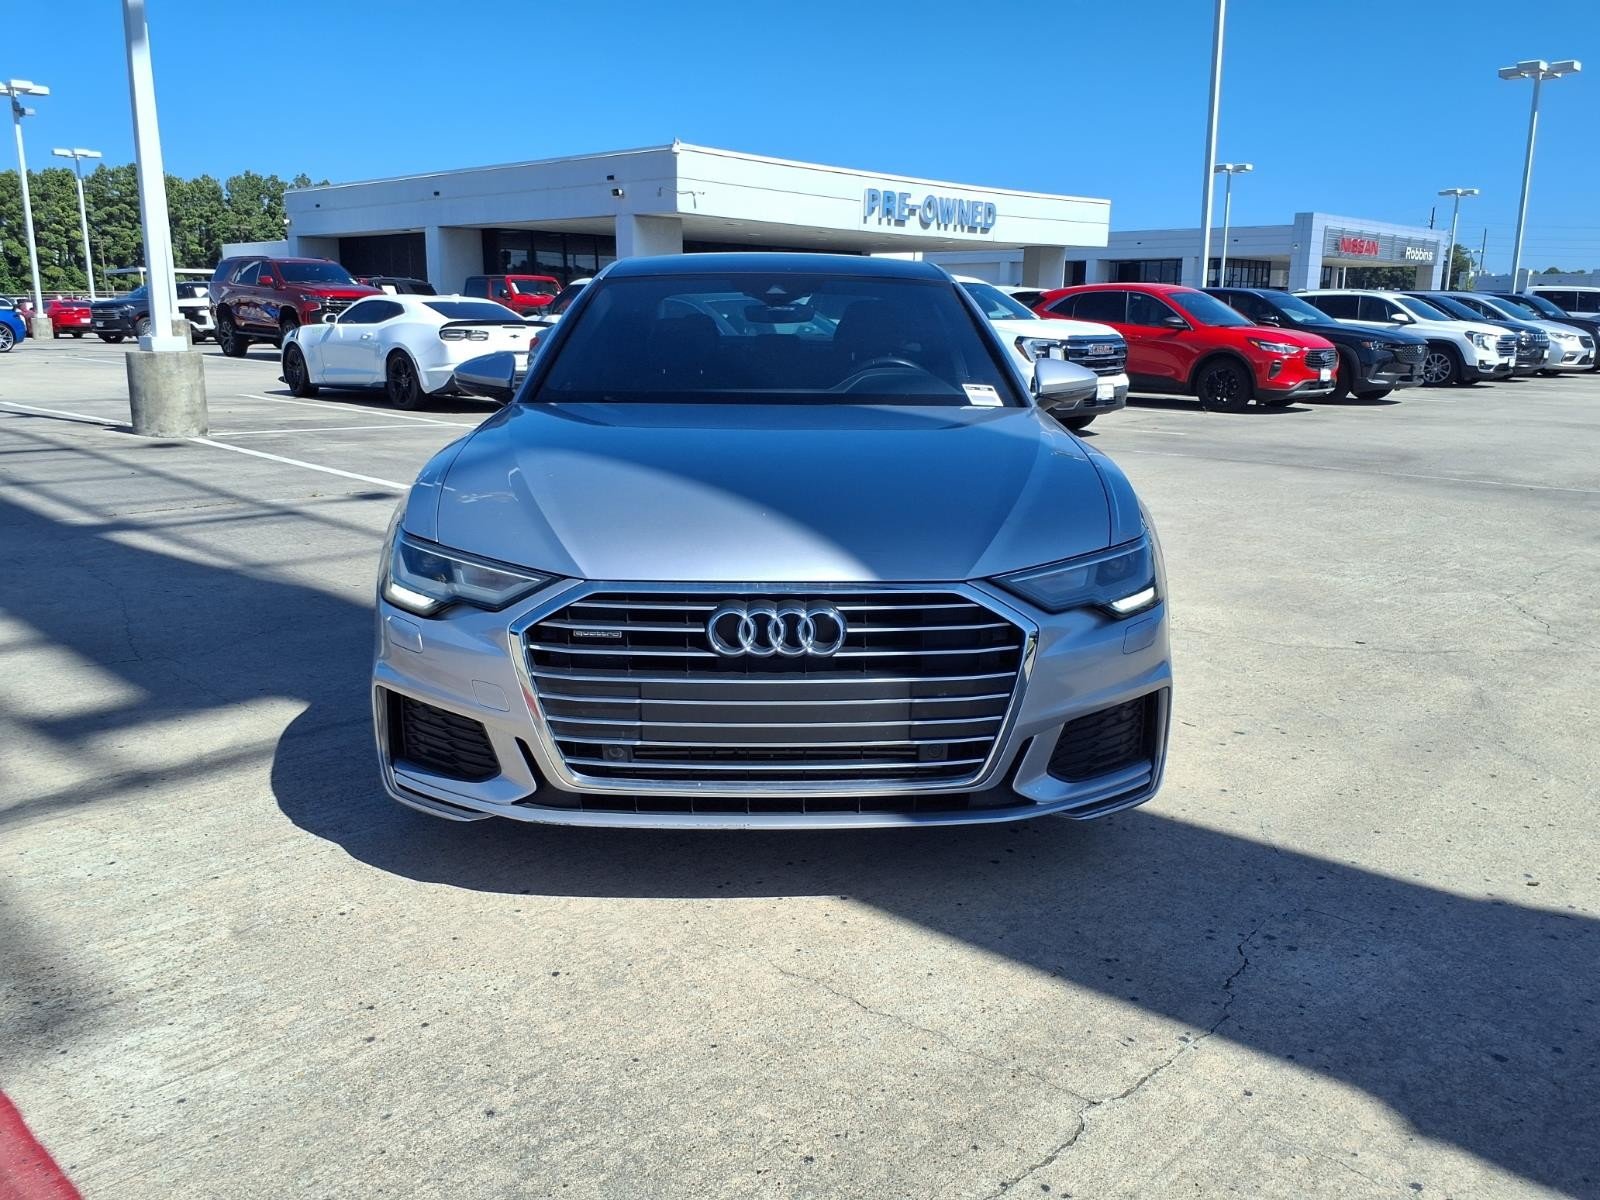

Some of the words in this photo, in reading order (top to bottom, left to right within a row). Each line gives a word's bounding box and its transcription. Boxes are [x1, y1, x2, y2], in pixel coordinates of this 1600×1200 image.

[864, 188, 997, 229] PRE-OWNED
[1339, 236, 1379, 256] NISSAN
[1405, 246, 1433, 261] Robbins
